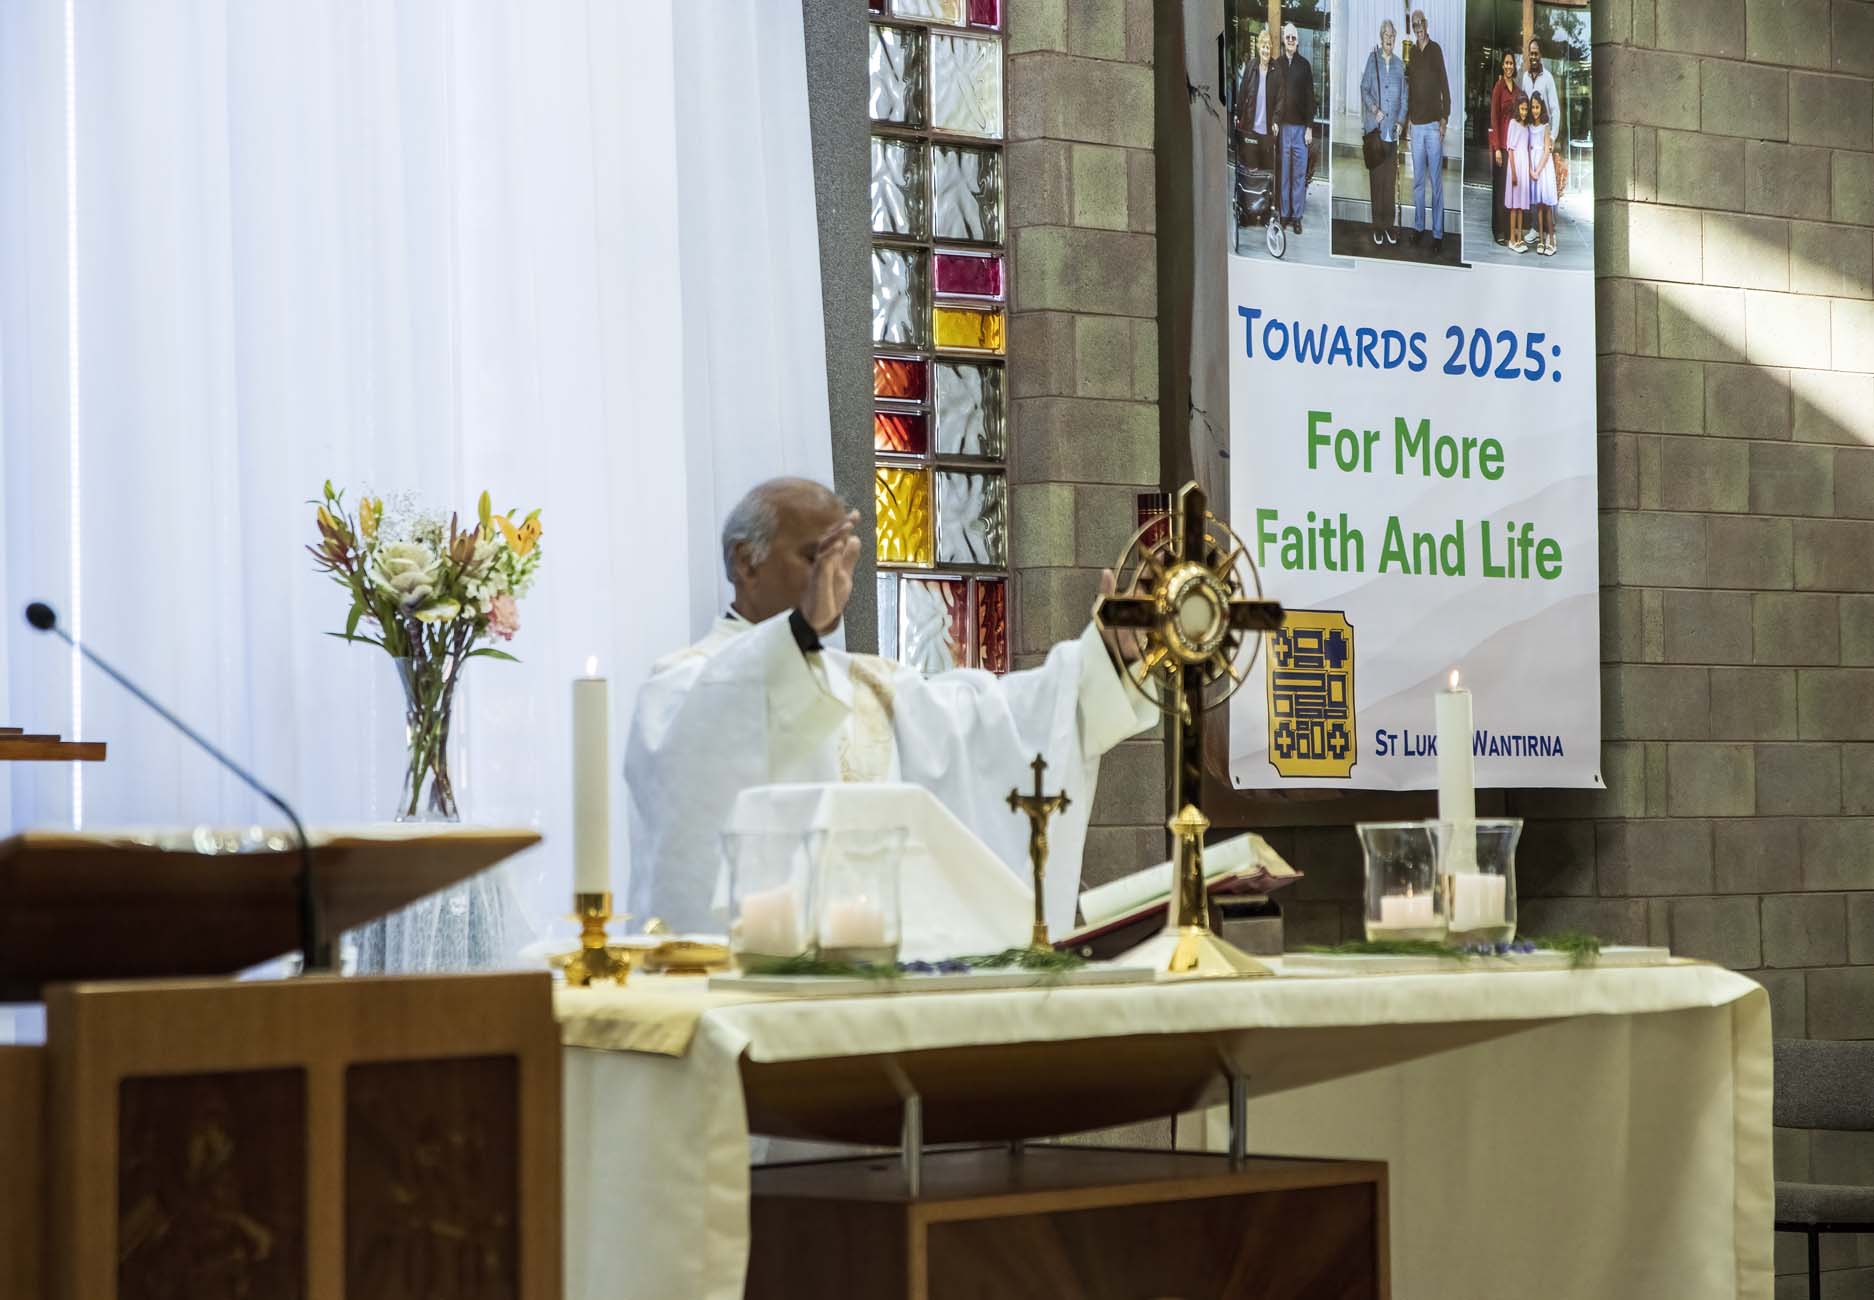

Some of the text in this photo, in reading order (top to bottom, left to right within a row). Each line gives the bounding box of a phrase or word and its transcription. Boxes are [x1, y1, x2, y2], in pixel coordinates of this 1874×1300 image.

[1238, 305, 1562, 383] TOWARDS 2025:
[1307, 410, 1505, 481] For More
[1256, 508, 1563, 581] Faith And Life
[1472, 730, 1564, 757] WANTIRNA
